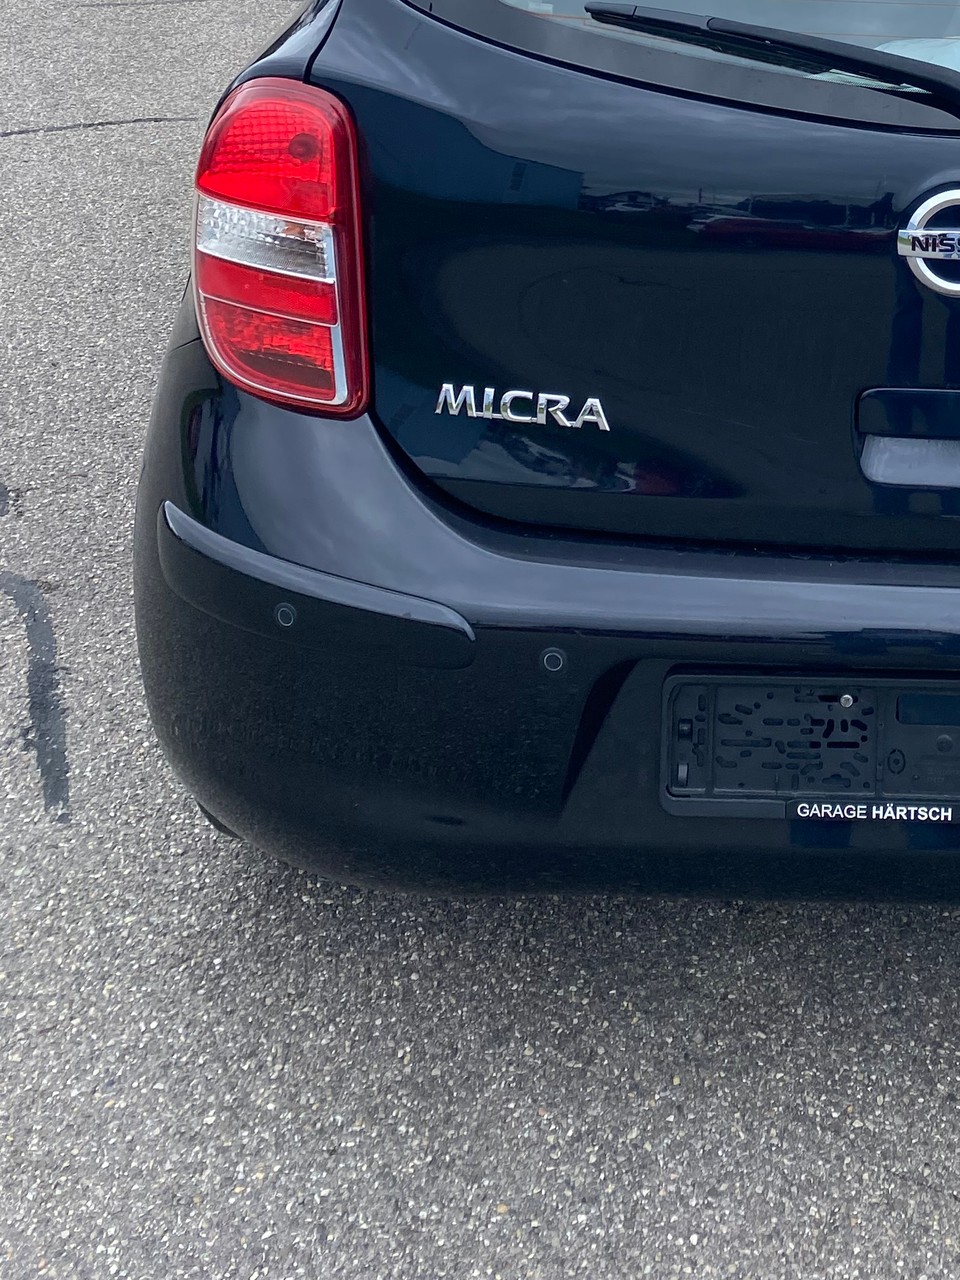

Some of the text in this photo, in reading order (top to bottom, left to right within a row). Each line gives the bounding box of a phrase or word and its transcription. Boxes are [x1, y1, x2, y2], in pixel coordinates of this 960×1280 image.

[435, 383, 610, 431] MICRA
[797, 803, 867, 819] GARAGE
[872, 803, 952, 821] HÄRTSCH
